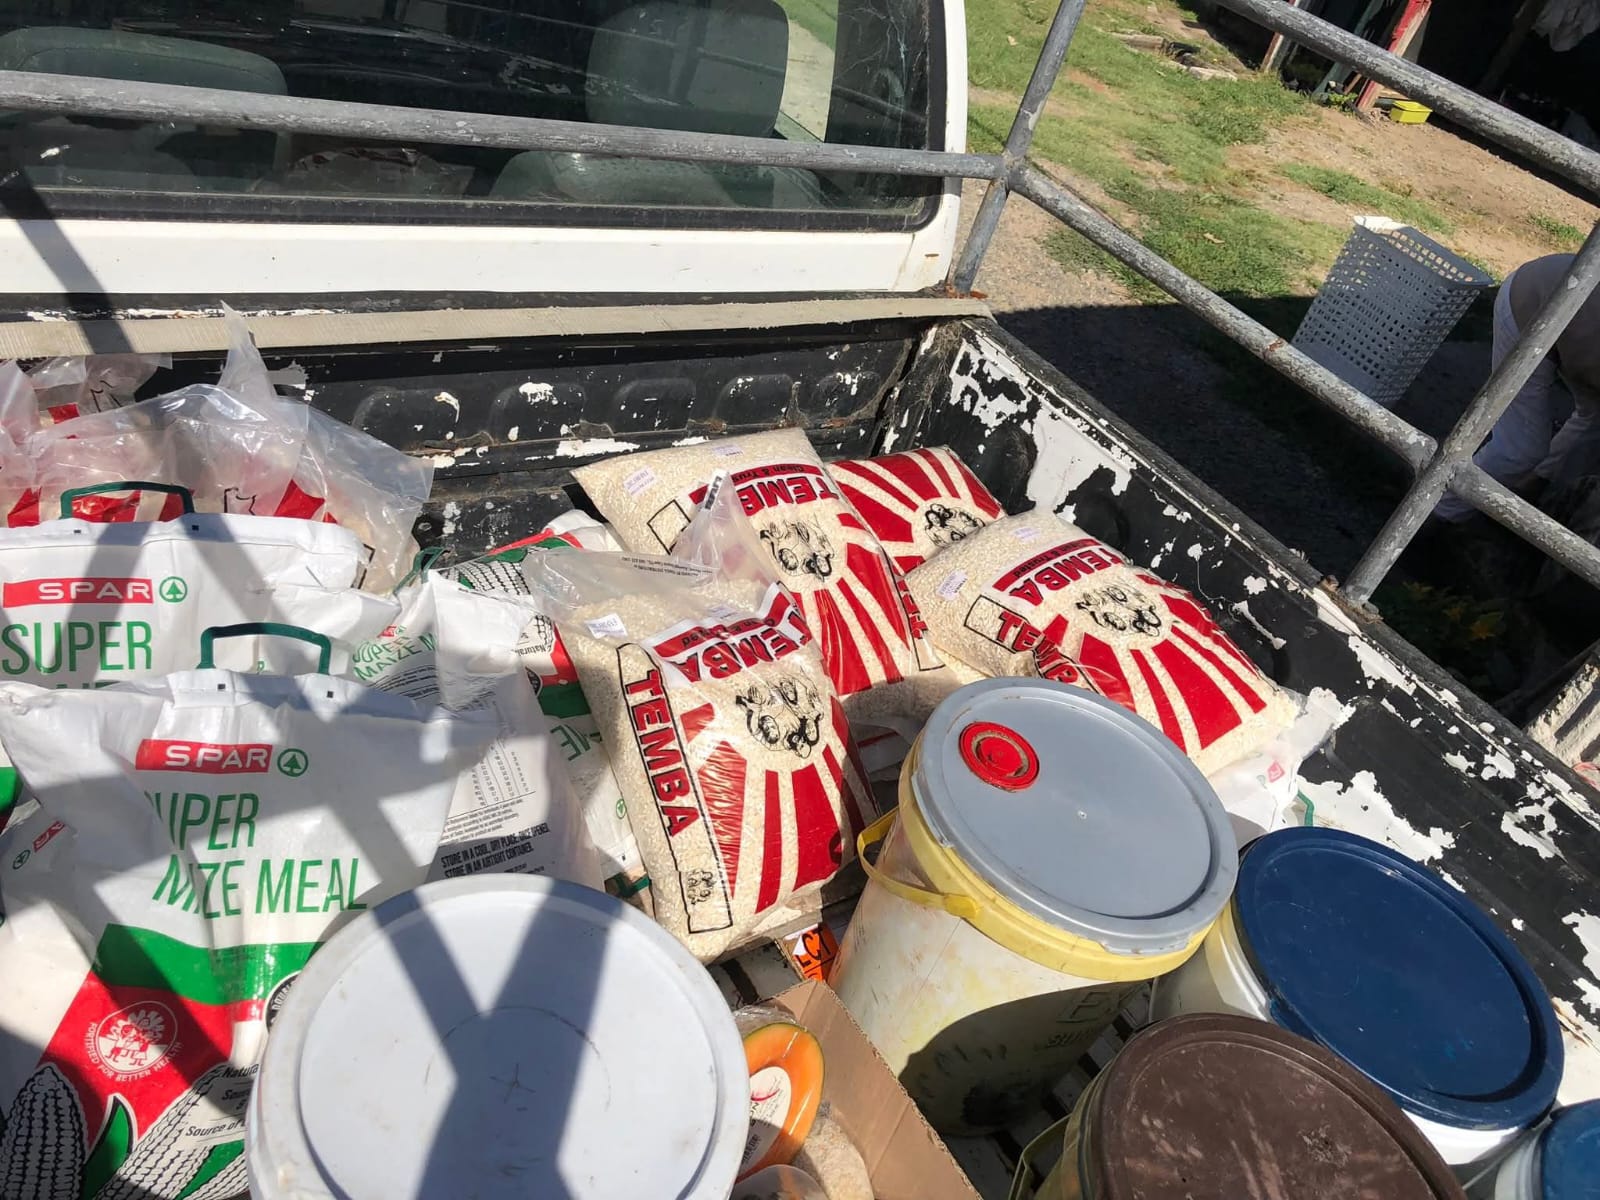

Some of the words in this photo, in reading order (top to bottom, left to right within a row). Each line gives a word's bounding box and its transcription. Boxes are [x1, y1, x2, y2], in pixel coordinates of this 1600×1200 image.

[736, 476, 839, 517] TEMB
[38, 580, 151, 601] SPAR
[1008, 546, 1124, 607] TEMBA
[1, 620, 153, 675] SUPER
[671, 610, 813, 684] TEMBA
[164, 744, 269, 769] SPAR
[624, 668, 700, 838] TEMBA
[144, 790, 260, 851] UPER
[255, 857, 368, 915] MEAL
[84, 1022, 100, 1065] FORTIFIED
[97, 1064, 115, 1079] FOR
[115, 1070, 152, 1083] BETTER
[153, 1041, 184, 1072] HEALTH
[221, 1063, 259, 1079] Natura
[185, 1124, 226, 1137] Source
